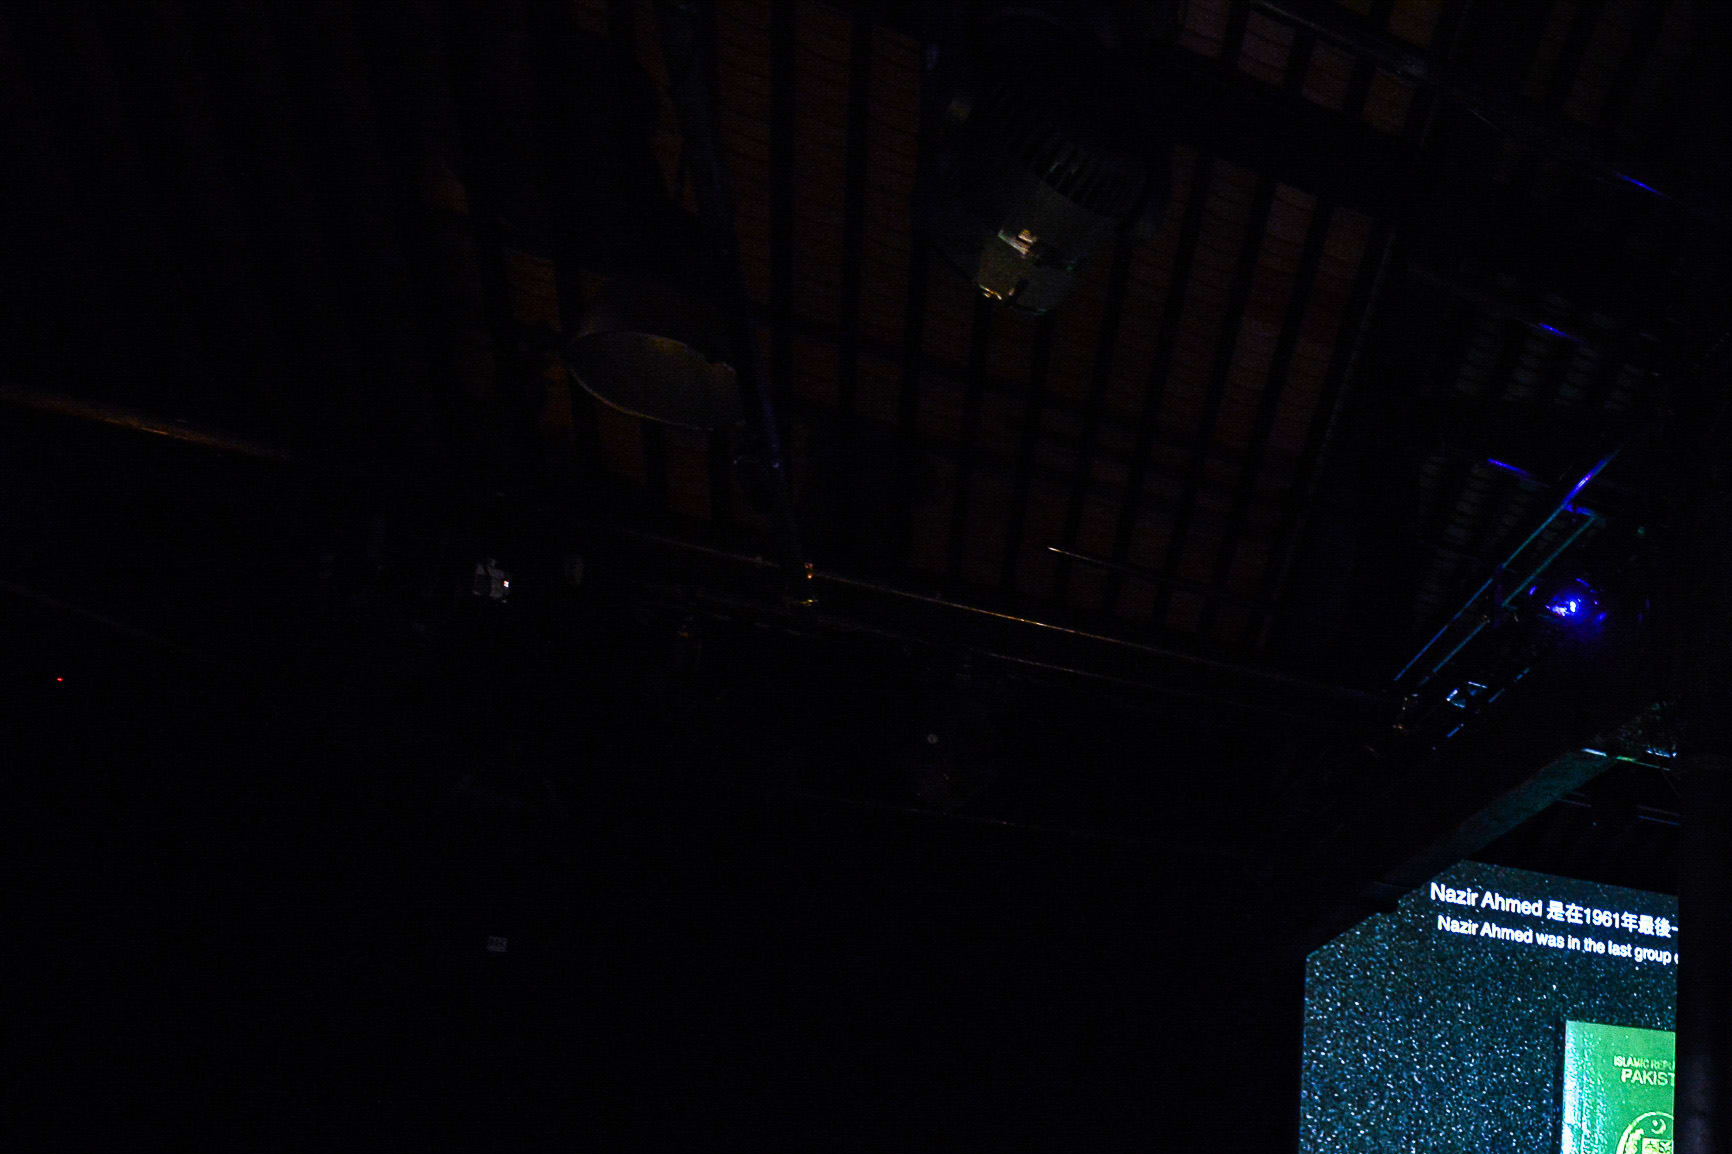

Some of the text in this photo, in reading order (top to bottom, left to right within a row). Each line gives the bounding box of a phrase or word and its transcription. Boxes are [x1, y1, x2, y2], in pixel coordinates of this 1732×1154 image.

[1430, 881, 1479, 906] Nazir
[1480, 890, 1543, 917] Ahmed
[1437, 914, 1479, 936] Nazir
[1480, 921, 1534, 944] Ahmed
[1536, 932, 1565, 949] was
[1567, 934, 1581, 951] in
[1583, 937, 1606, 954] the
[1607, 939, 1632, 958] last
[1634, 946, 1672, 966] group
